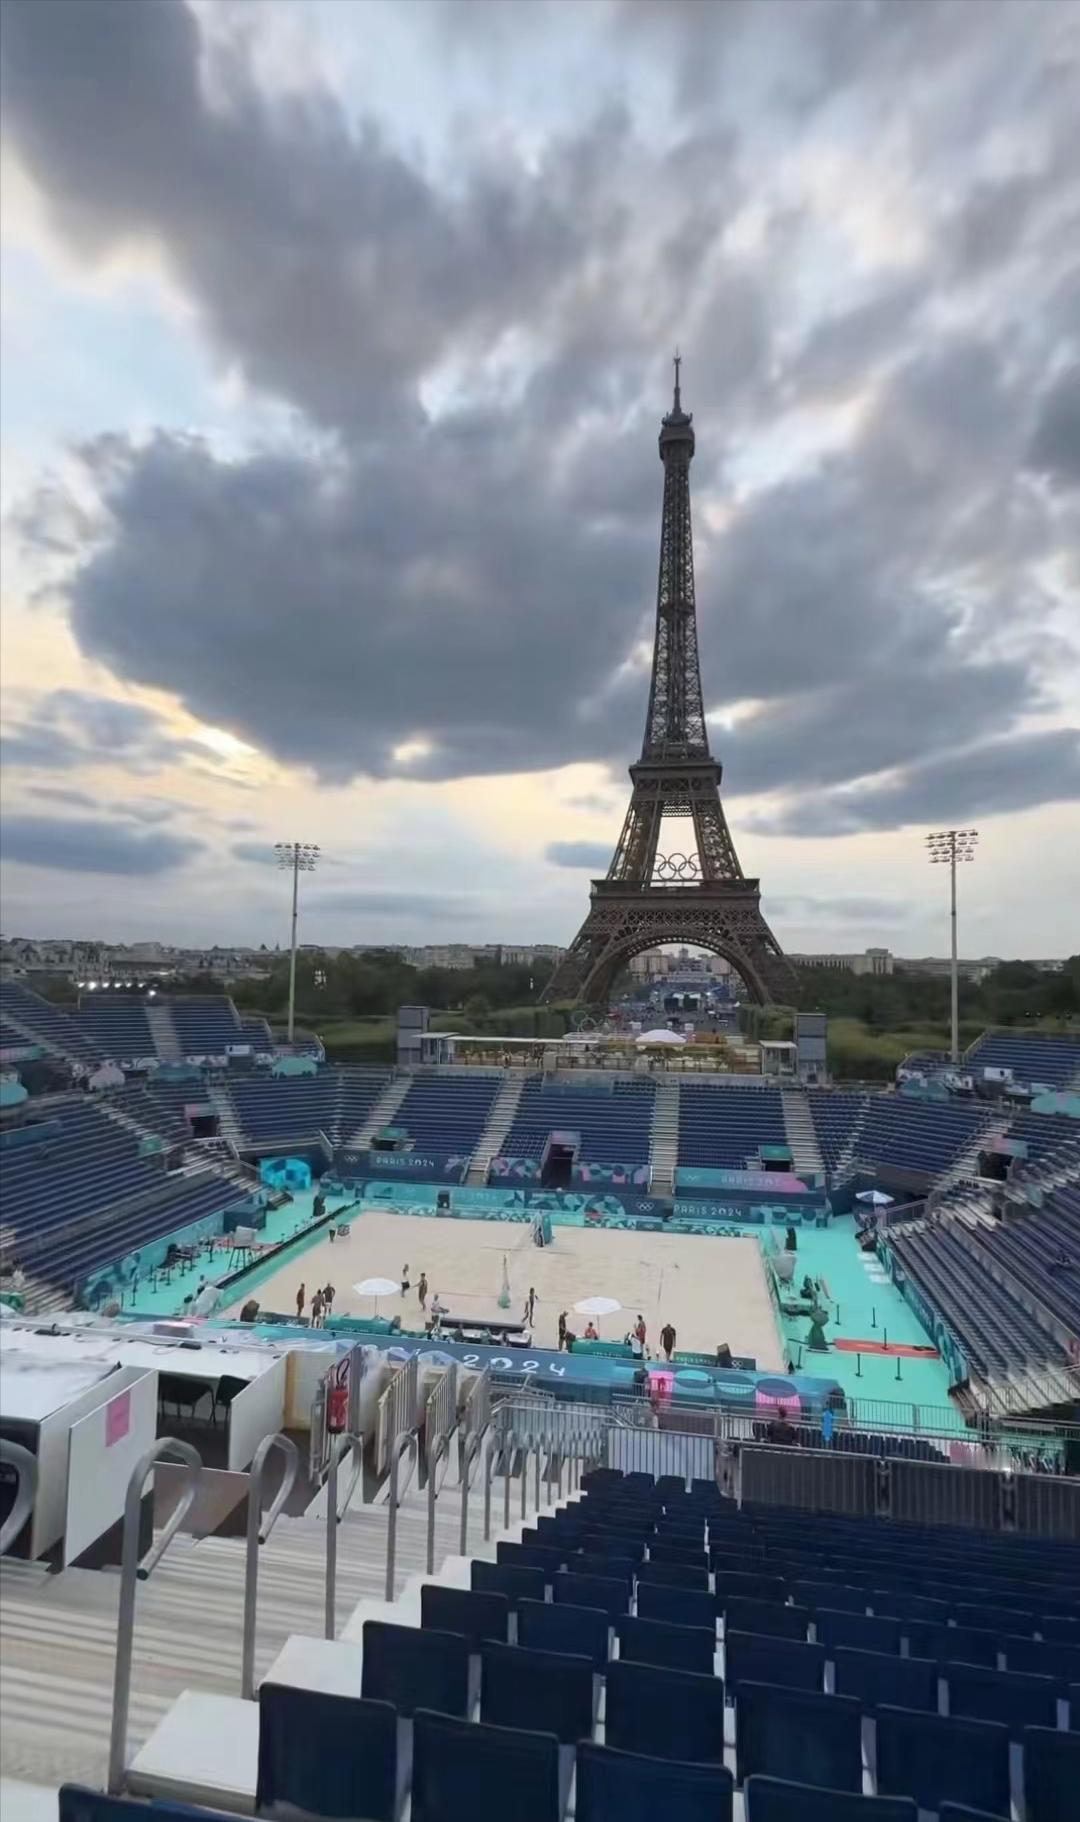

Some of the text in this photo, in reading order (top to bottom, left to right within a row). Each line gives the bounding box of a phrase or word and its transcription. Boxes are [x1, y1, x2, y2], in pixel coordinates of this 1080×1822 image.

[408, 1159, 434, 1168] 2024
[674, 1204, 742, 1217] PARIS 2024
[463, 1354, 566, 1377] 2024
